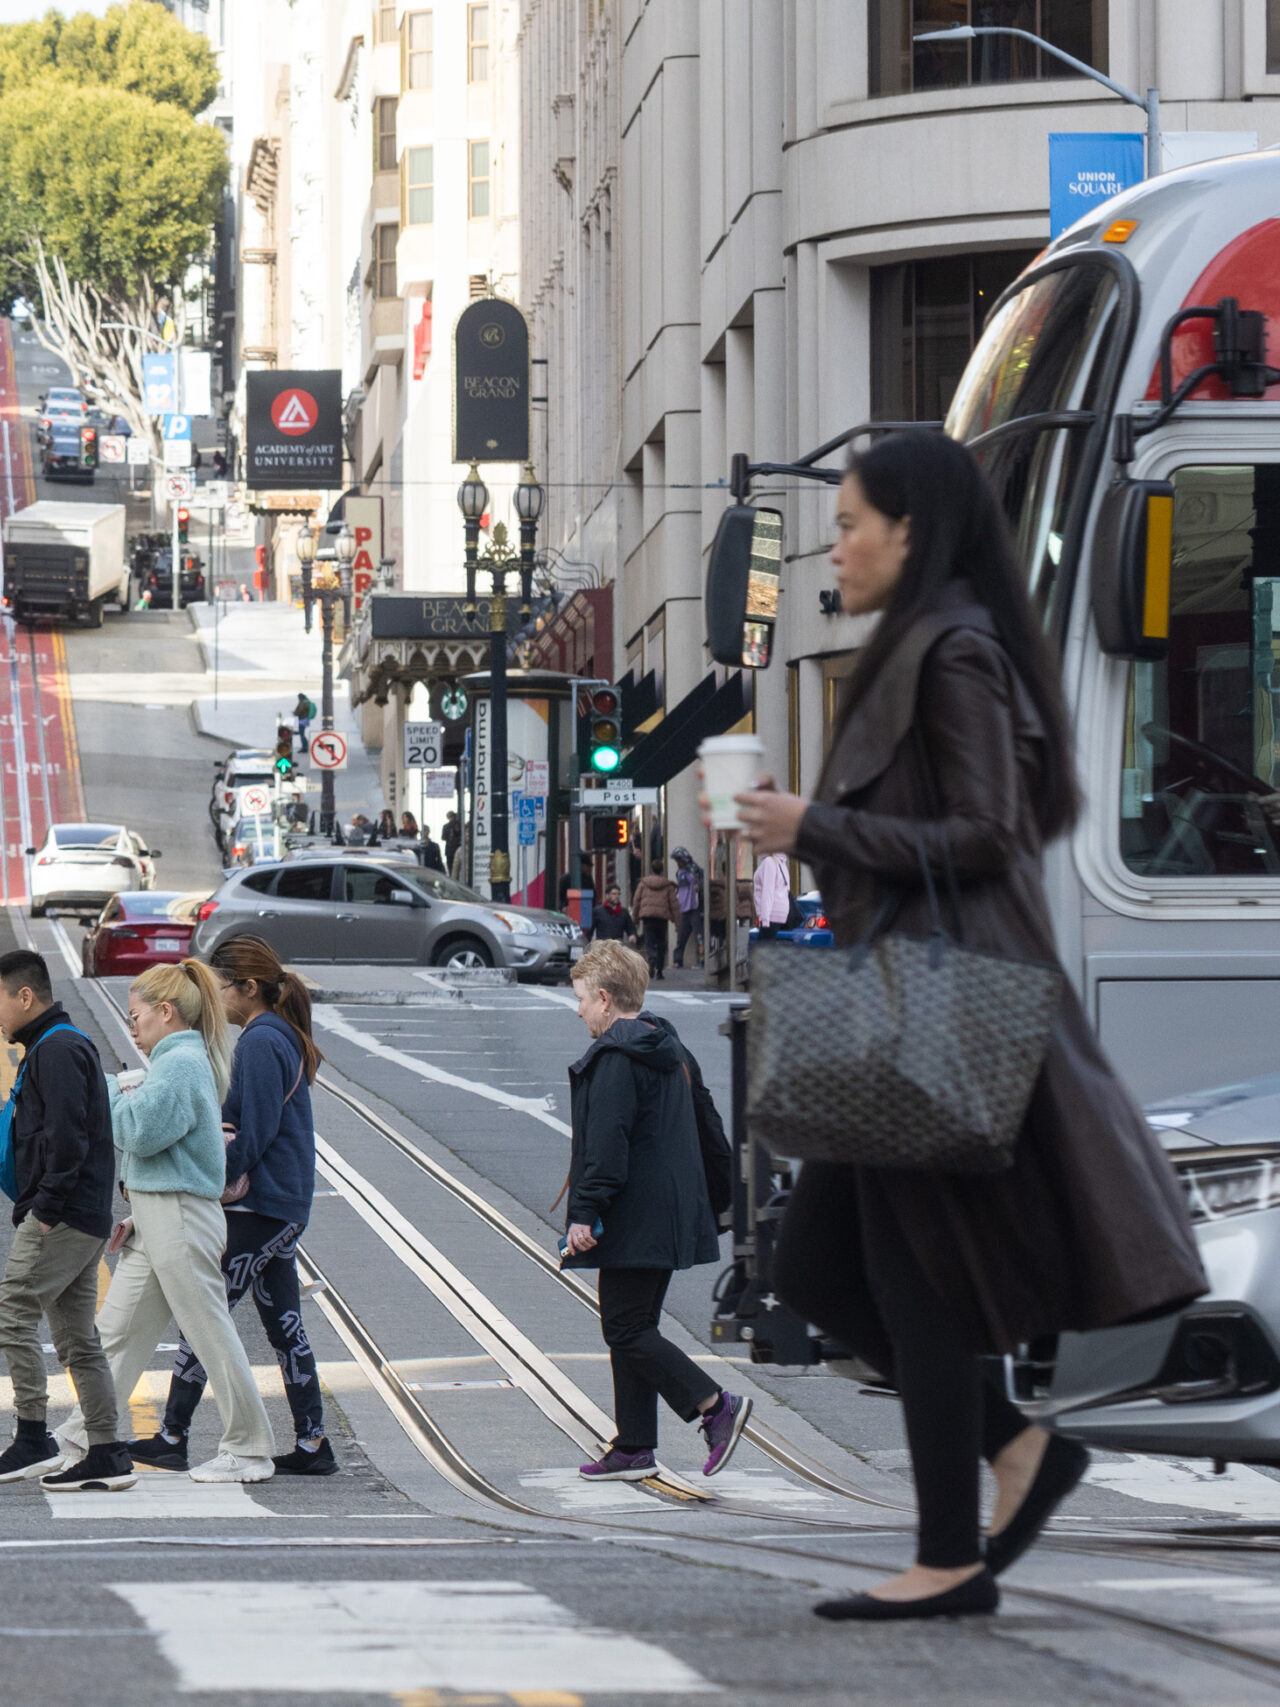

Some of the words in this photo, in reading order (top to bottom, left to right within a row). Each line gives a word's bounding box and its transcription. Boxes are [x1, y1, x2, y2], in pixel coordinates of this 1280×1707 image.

[1078, 172, 1116, 182] UNION
[464, 376, 520, 389] BEACON
[469, 388, 516, 398] GRAND
[168, 416, 187, 438] P
[255, 445, 305, 455] ACADEMY
[314, 445, 335, 455] ART
[255, 456, 335, 467] UNIVERSITY
[431, 618, 492, 633] GRAN
[407, 726, 439, 735] SPEED
[409, 736, 435, 745] LIMIT
[408, 746, 438, 764] 20
[603, 791, 637, 801] Post
[618, 820, 627, 843] 3
